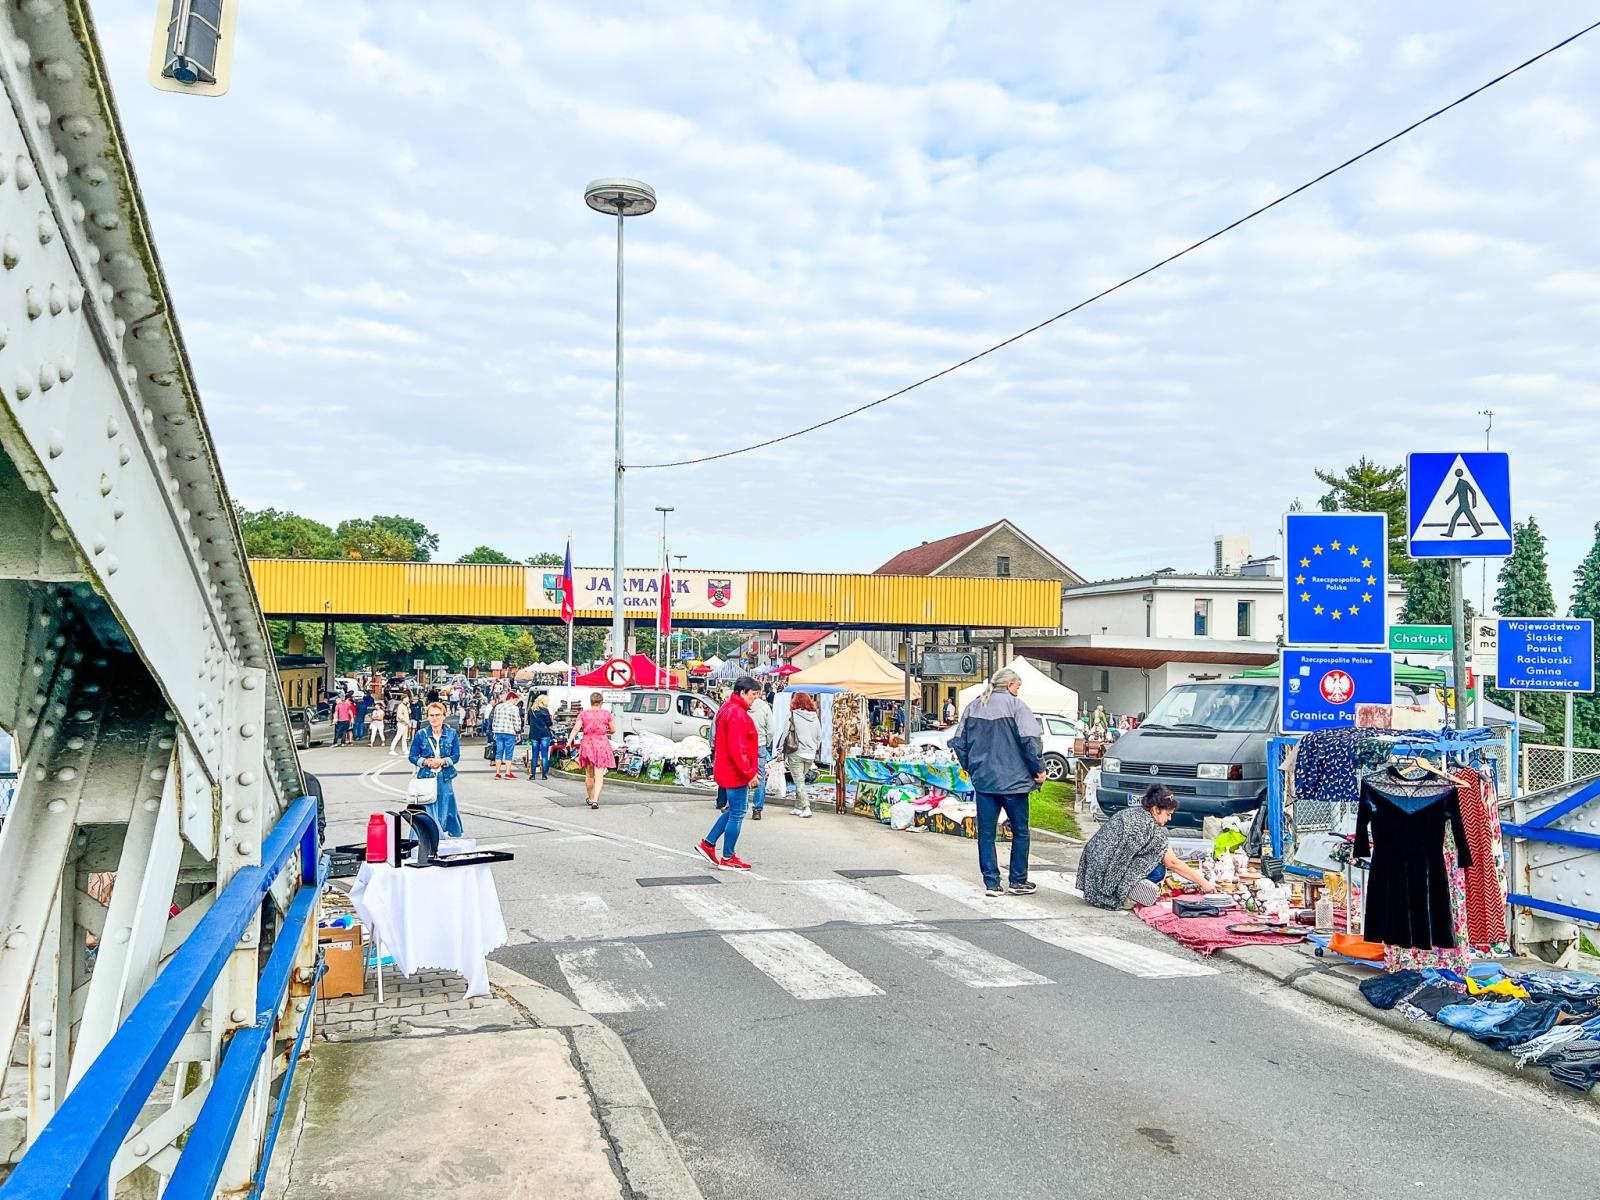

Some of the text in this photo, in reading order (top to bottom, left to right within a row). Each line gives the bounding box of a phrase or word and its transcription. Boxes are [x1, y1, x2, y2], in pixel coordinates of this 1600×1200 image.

[585, 577, 691, 594] JAMAK
[623, 597, 677, 607] GRANY
[1508, 622, 1581, 632] Województwo
[1394, 633, 1448, 646] Chałupki
[1526, 631, 1563, 643] Śląskie
[1527, 644, 1562, 653] Powiat
[1301, 656, 1350, 664] Rzeczpospolita
[1517, 655, 1572, 665] Raciborski
[1526, 666, 1562, 675] Gmina
[1509, 677, 1580, 688] Krzyżanowice
[1290, 710, 1335, 720] Granica
